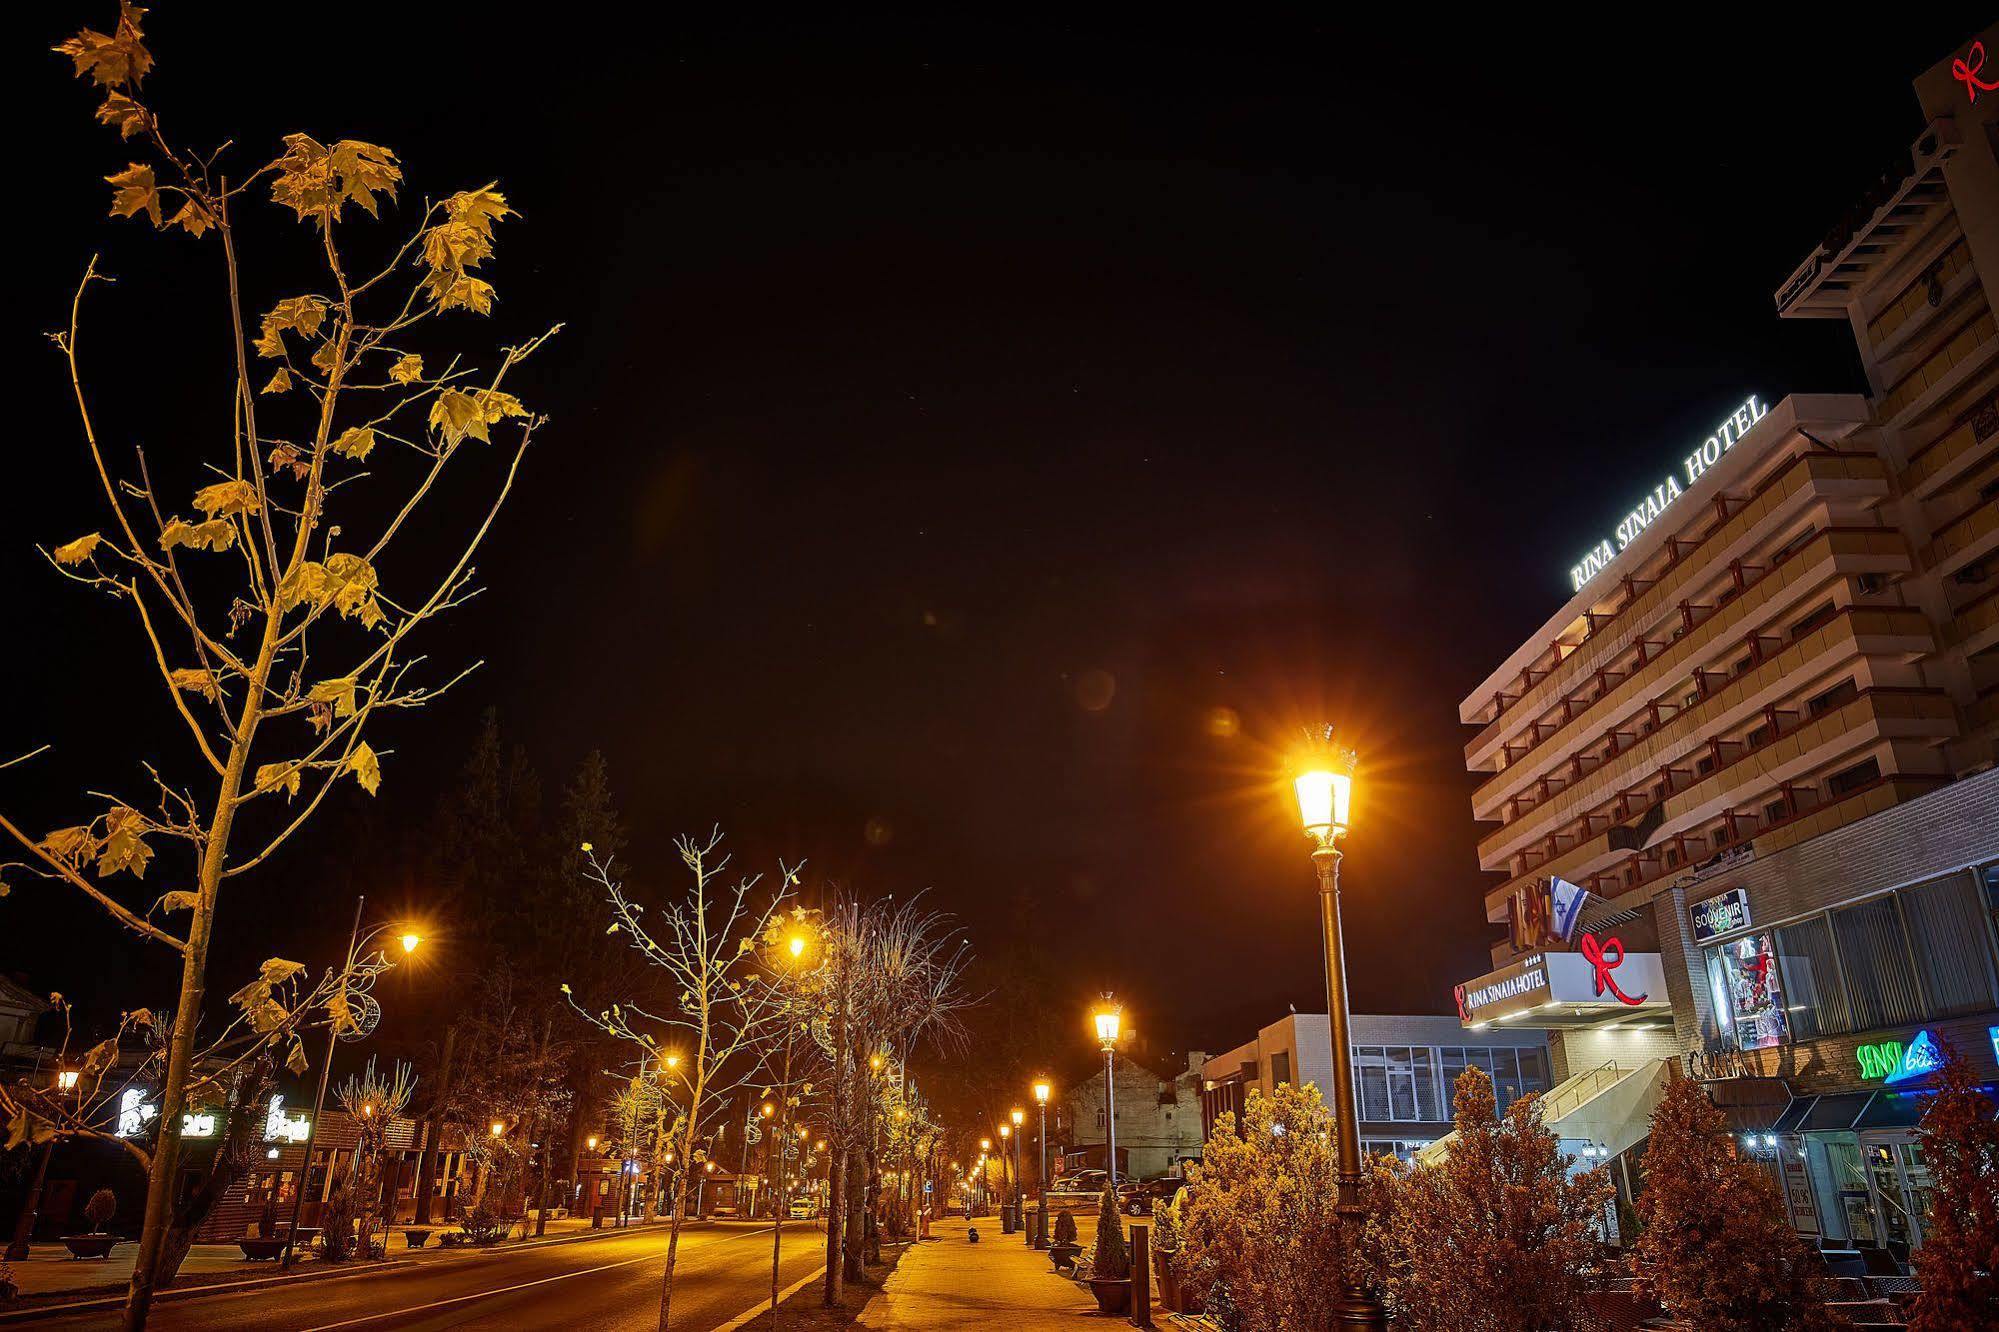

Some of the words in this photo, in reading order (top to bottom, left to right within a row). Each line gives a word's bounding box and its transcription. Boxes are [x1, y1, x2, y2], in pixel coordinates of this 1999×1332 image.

[1570, 538, 1616, 592] RINA
[1615, 475, 1682, 550] SINAIA
[1684, 394, 1769, 485] HOTEL
[1694, 902, 1742, 929] SOUVENIR
[1467, 988, 1487, 1009] RINA
[1487, 977, 1518, 1002] SINAIA
[1517, 969, 1546, 994] HOTEL
[1857, 1041, 1904, 1080] SENSI
